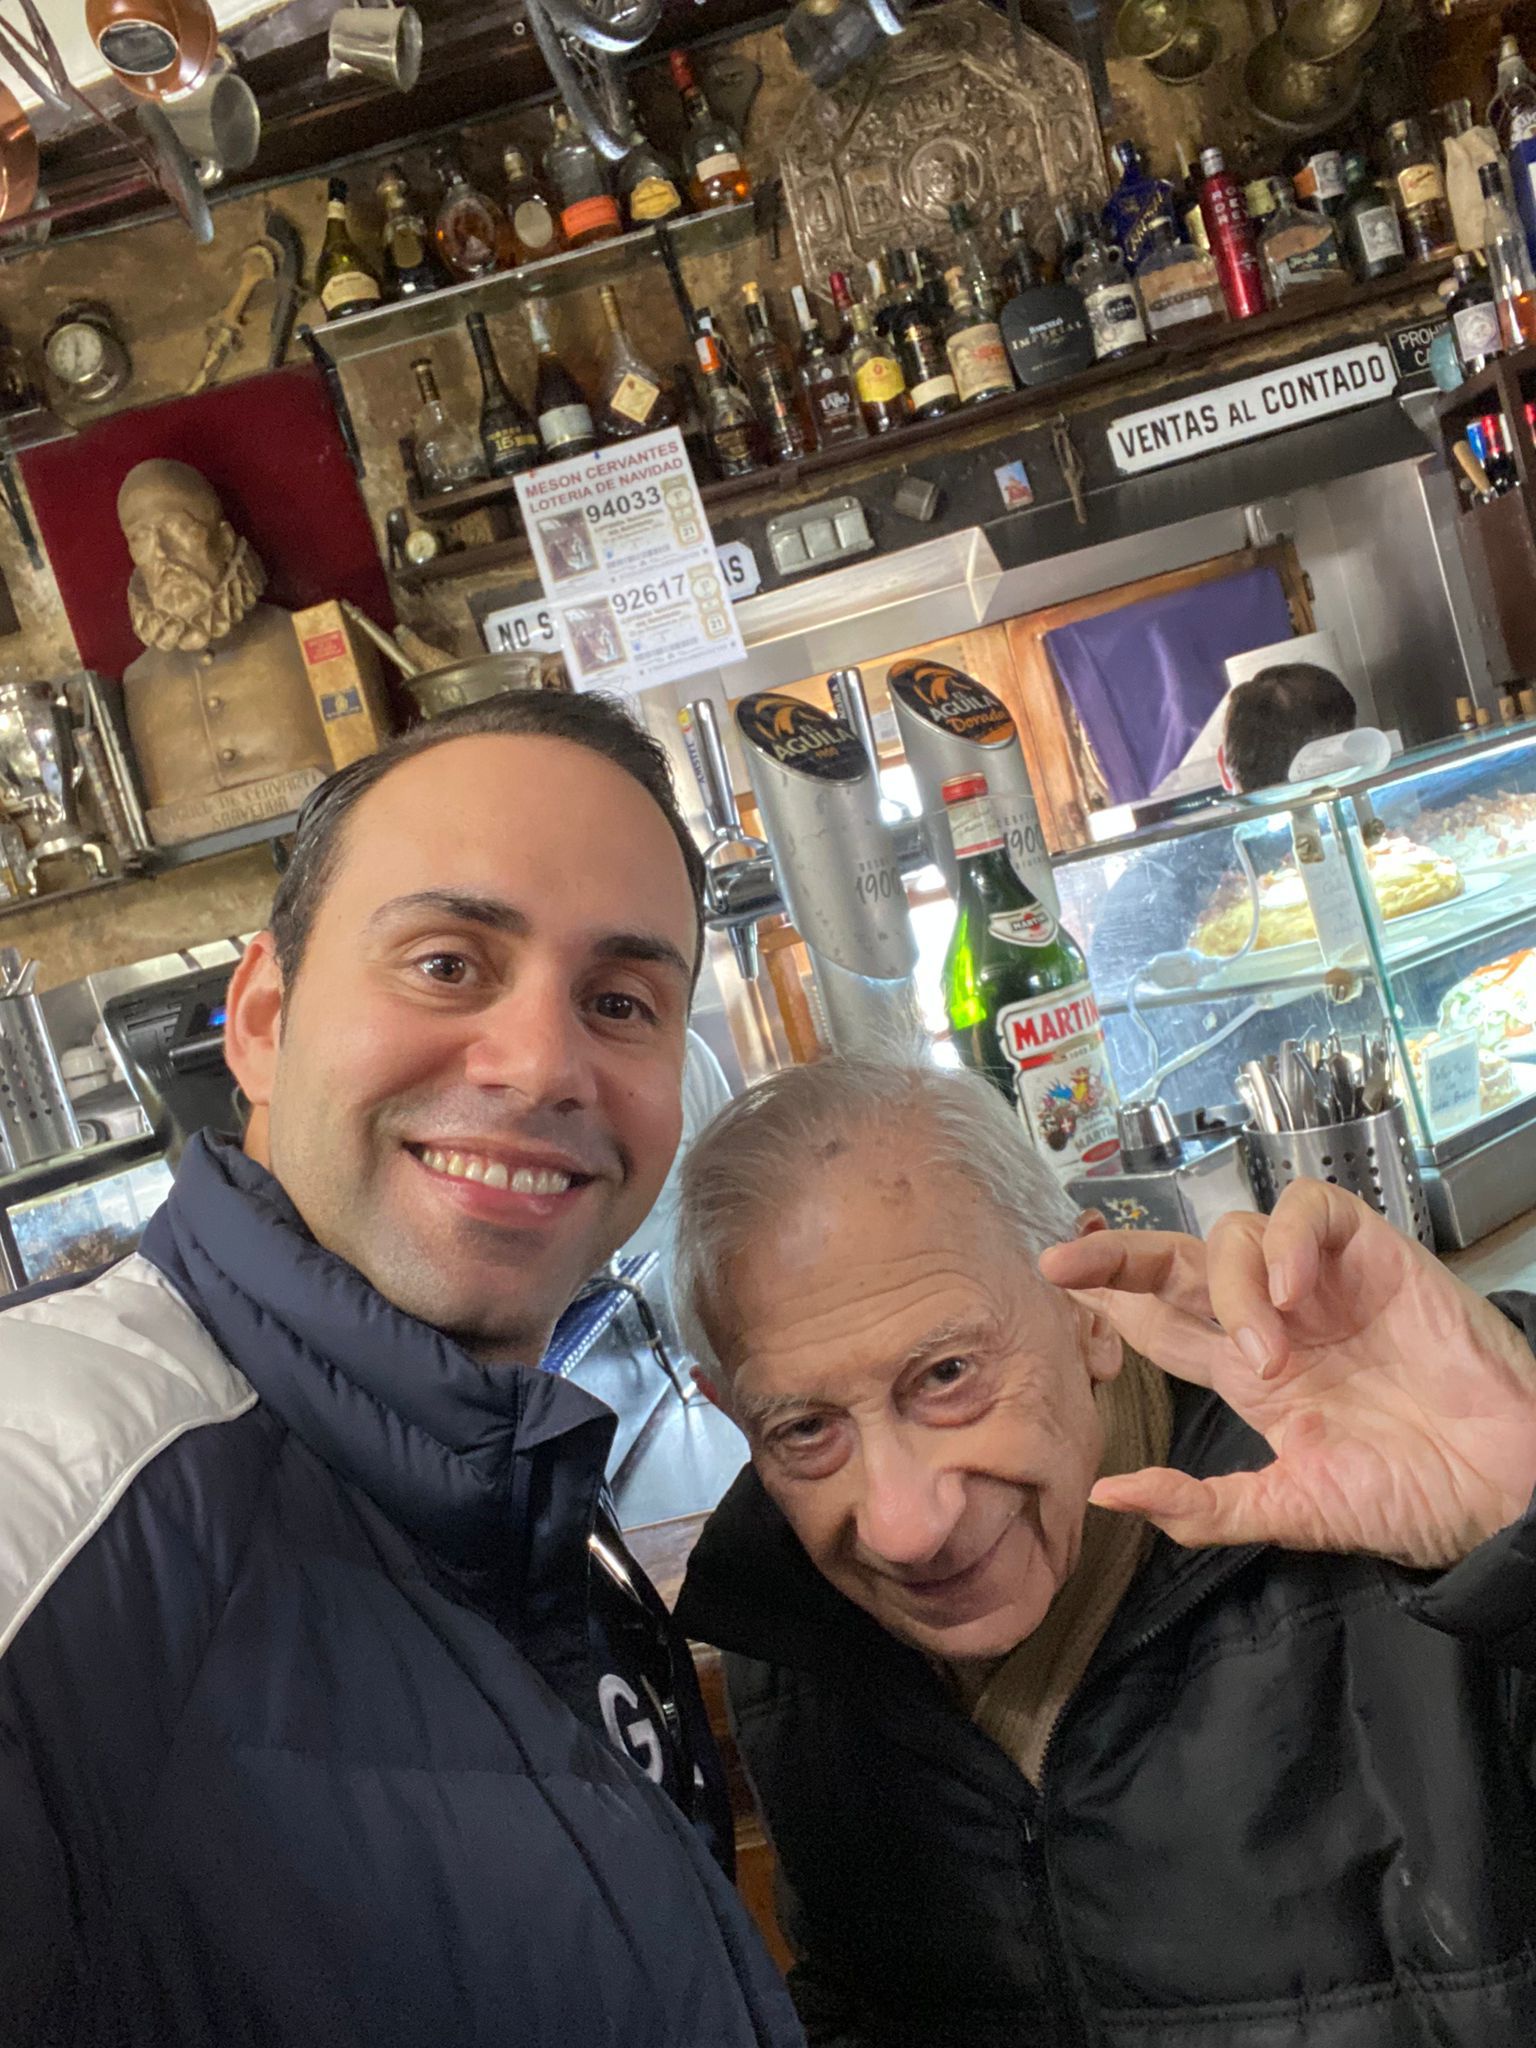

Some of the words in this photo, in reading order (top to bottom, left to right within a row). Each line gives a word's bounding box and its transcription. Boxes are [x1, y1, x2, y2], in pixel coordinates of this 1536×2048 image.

[1117, 405, 1219, 458] VENTAS
[1228, 400, 1257, 427] AL
[1261, 355, 1386, 415] CONTADO
[525, 472, 582, 498] MESON
[586, 441, 679, 480] CERVANTES
[529, 487, 592, 514] LOTERIA
[596, 481, 616, 494] DE
[619, 458, 684, 487] NAVIDAD
[586, 486, 661, 523] 94033
[612, 574, 684, 614] 92617
[497, 618, 531, 651] NO
[1012, 995, 1098, 1052] MARTIN
